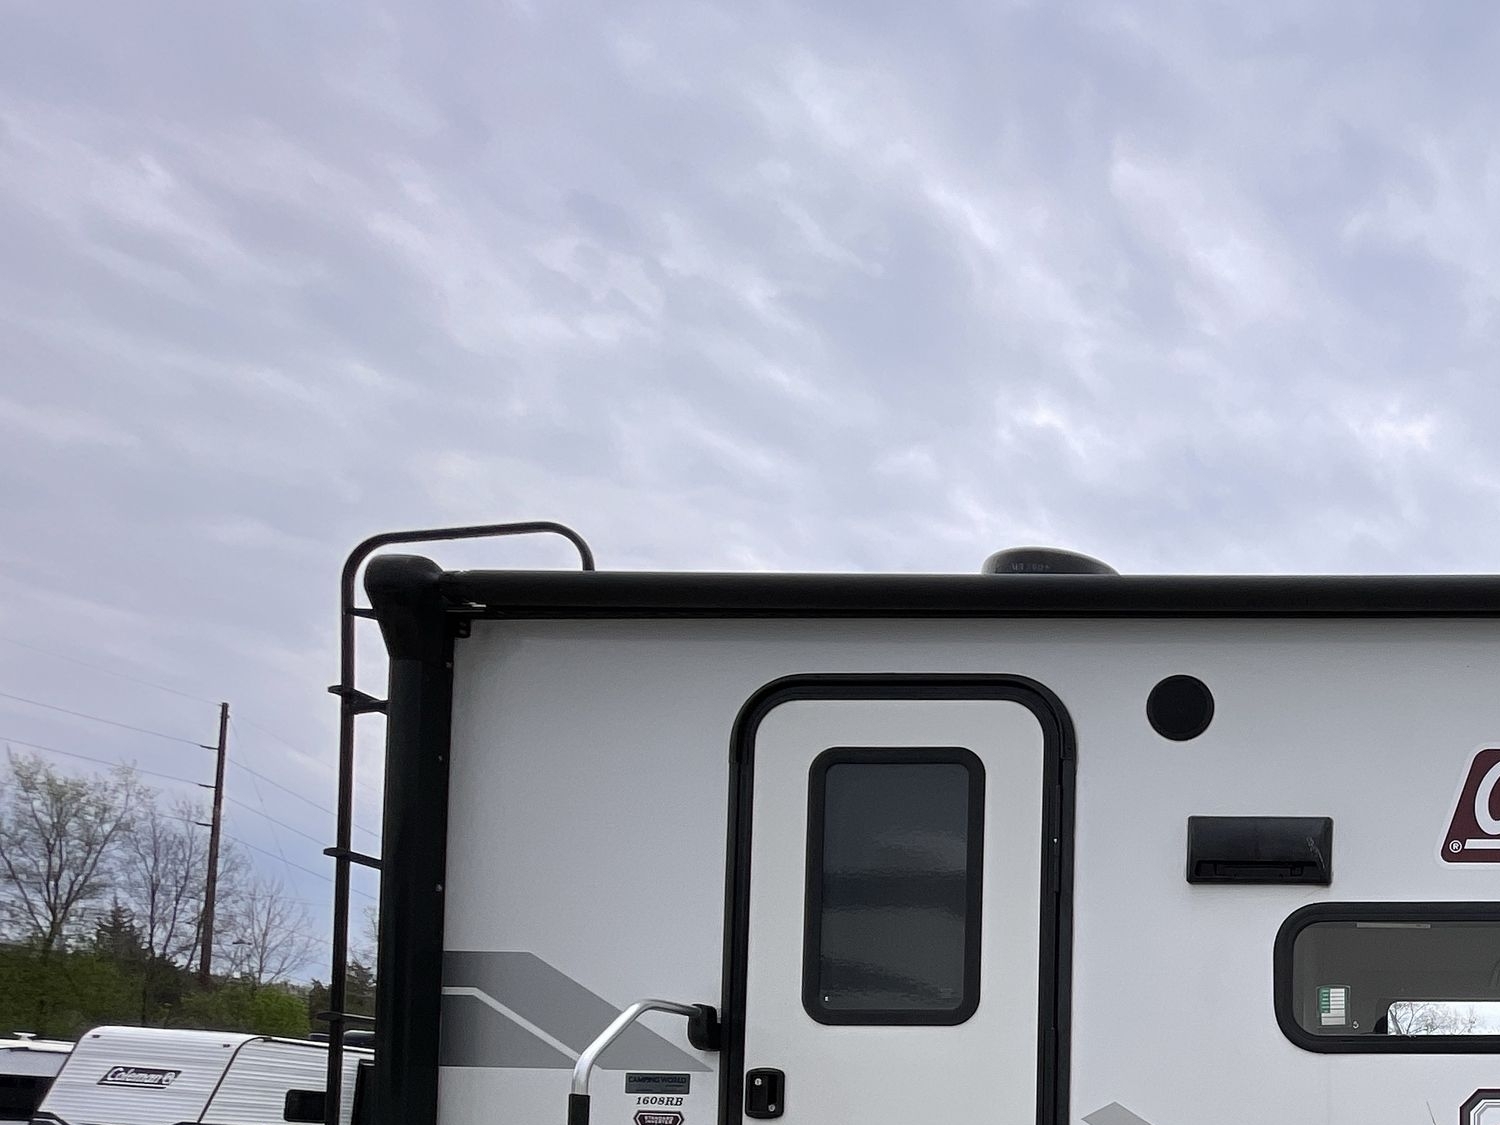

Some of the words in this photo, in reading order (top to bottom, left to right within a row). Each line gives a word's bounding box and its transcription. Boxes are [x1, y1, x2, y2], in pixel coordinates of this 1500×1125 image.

[106, 1067, 163, 1083] Coleman
[660, 1076, 687, 1084] WORLD
[636, 1096, 684, 1106] 1608RB
